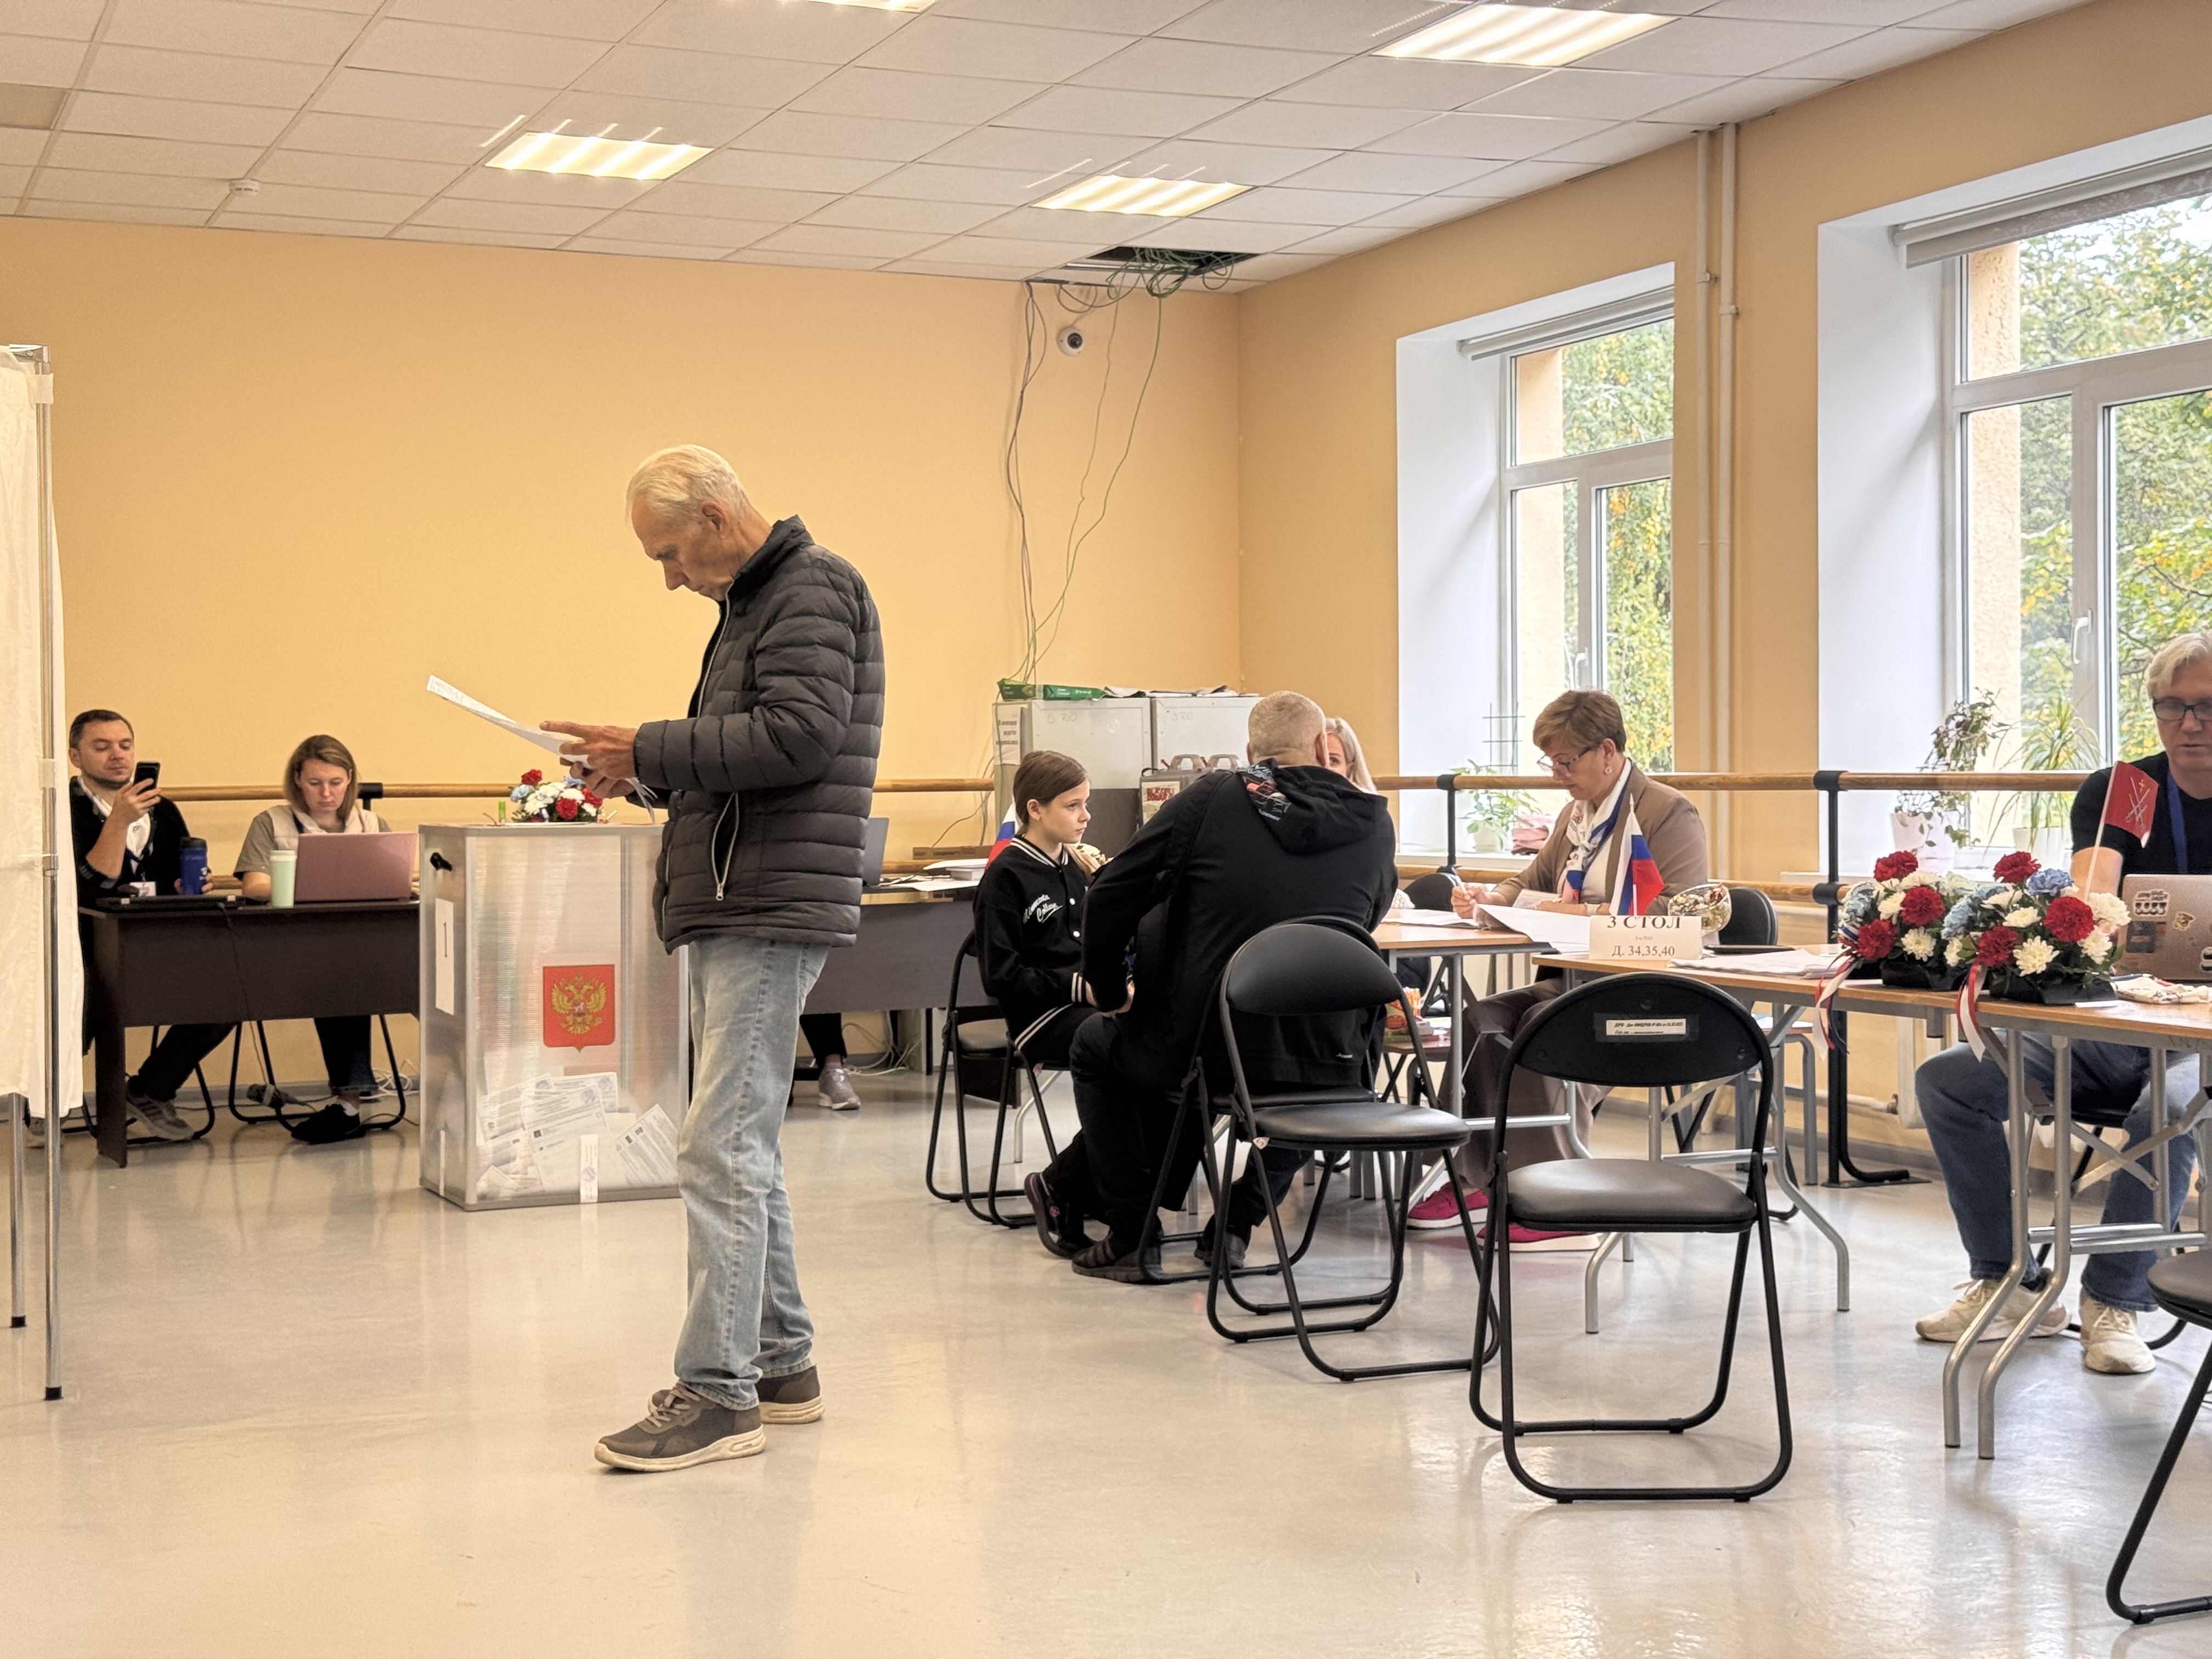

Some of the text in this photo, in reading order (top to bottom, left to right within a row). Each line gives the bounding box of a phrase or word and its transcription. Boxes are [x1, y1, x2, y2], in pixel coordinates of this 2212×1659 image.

[1607, 916, 1681, 929] 3 СТОЛ
[1611, 945, 1625, 957] Д.
